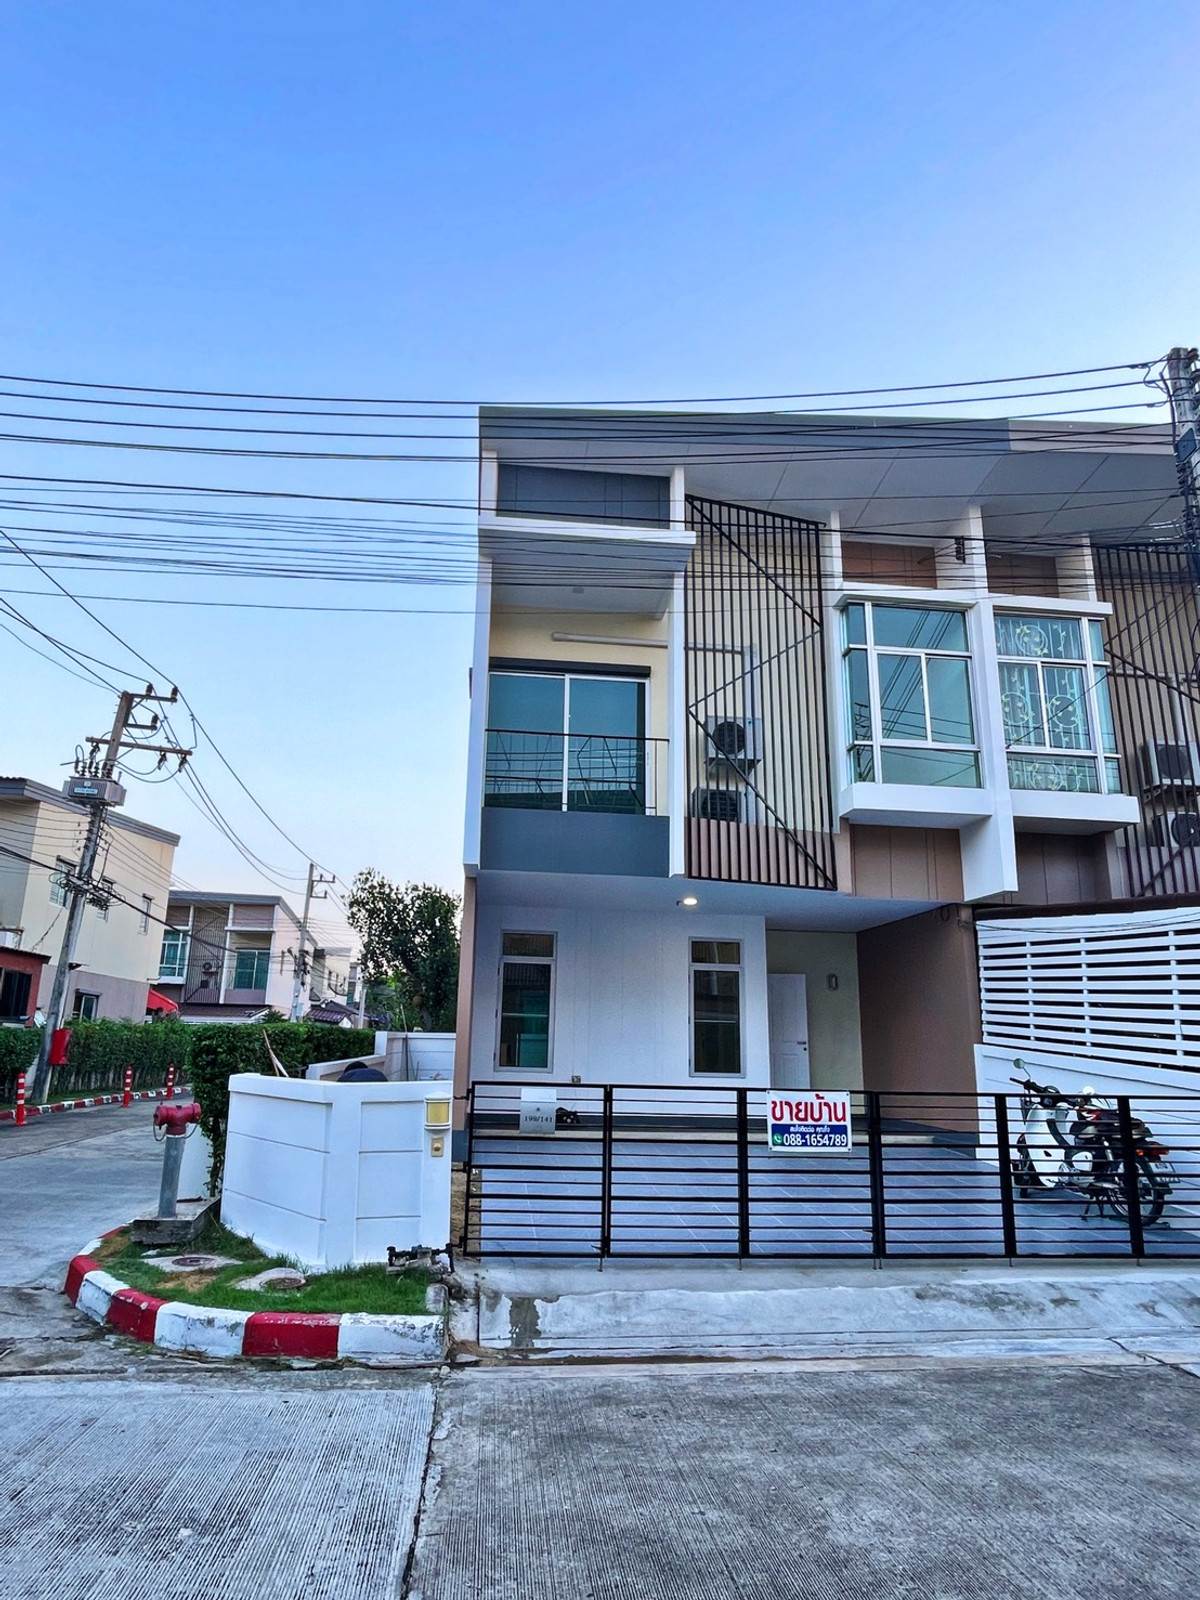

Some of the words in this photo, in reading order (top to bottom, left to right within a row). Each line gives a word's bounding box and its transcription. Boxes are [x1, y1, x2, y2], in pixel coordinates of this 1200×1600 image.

[771, 1093, 846, 1122] ขายบ้าน
[783, 1133, 847, 1146] 088-1654789
